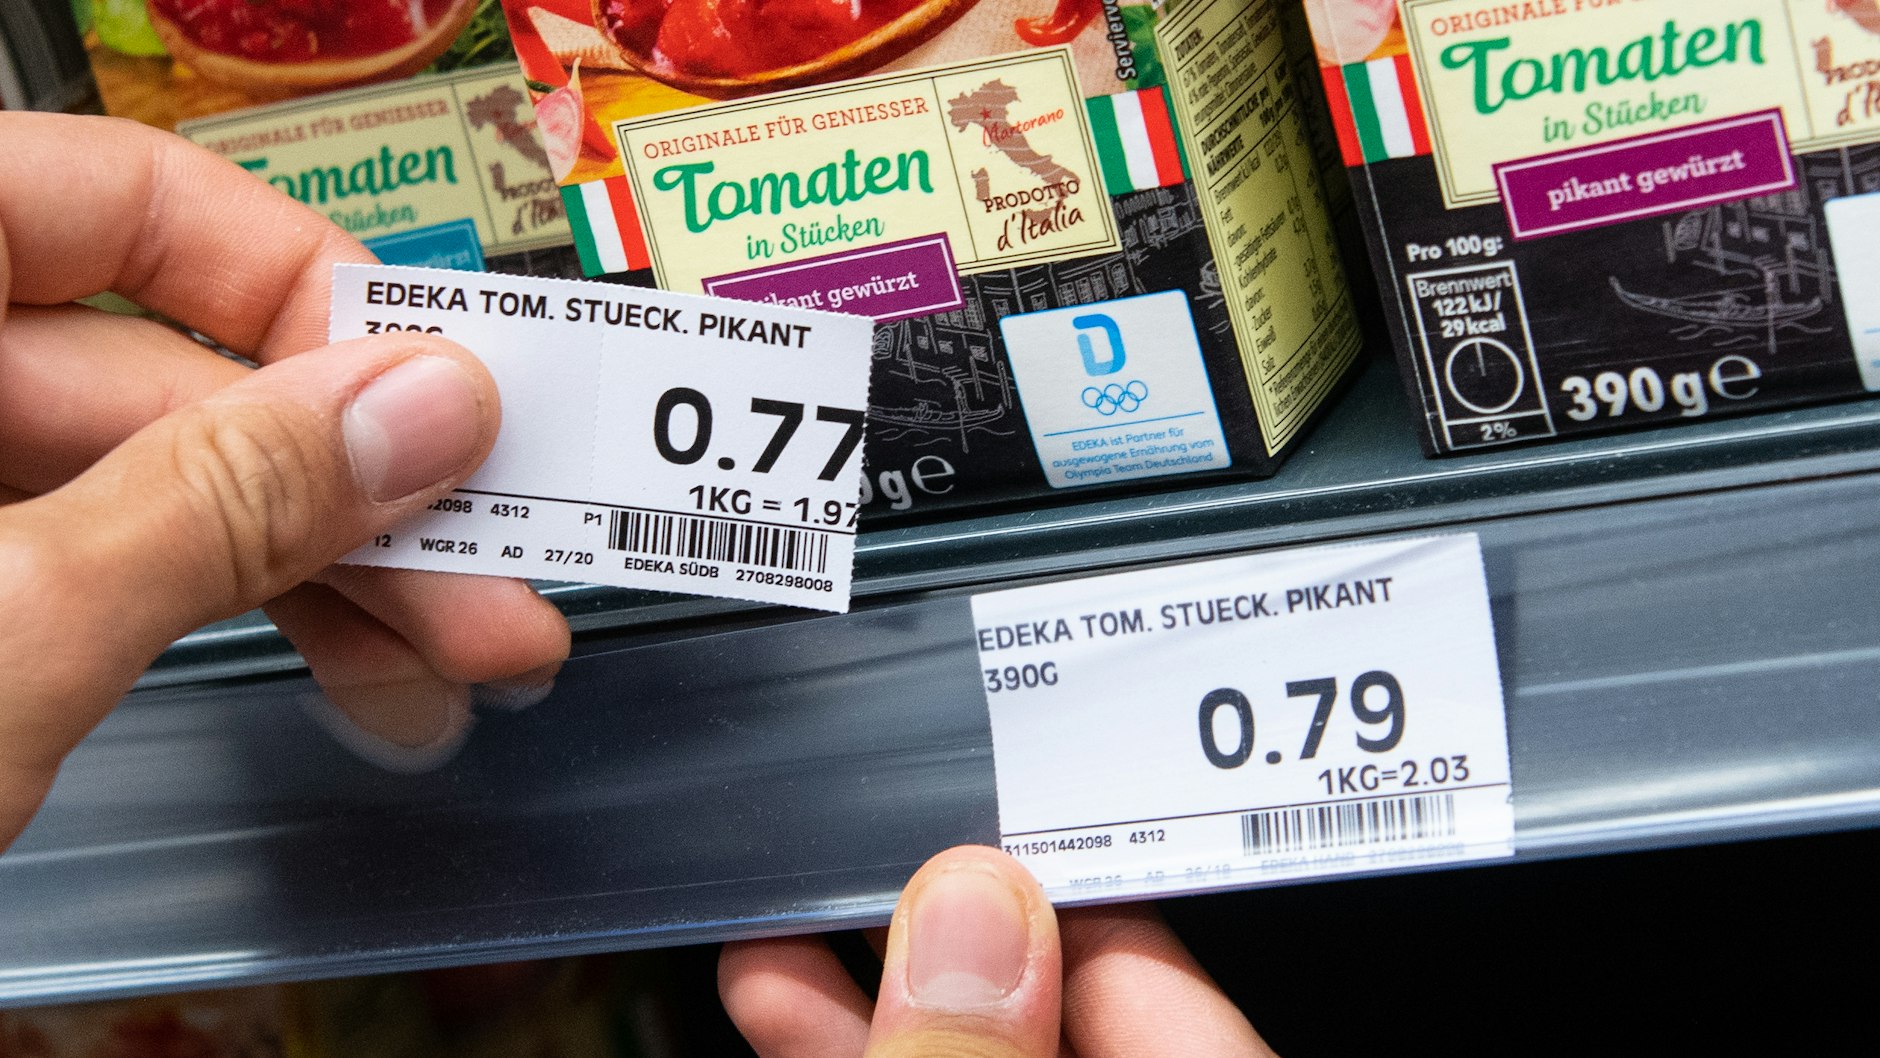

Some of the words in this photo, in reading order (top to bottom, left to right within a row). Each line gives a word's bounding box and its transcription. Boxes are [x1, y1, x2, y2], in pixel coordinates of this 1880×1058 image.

[1431, 0, 1567, 36] ORIGINALE
[1440, 18, 1766, 115] Tomaten
[643, 123, 762, 160] ORIGINALE
[766, 117, 806, 140] FÜR
[811, 97, 929, 132] GENIESSER
[1543, 116, 1575, 144] in
[1581, 89, 1708, 136] Stücken
[236, 145, 458, 206] omaten
[653, 148, 934, 234] Tomaten
[1547, 171, 1632, 211] pikant
[1636, 150, 1745, 193] gewürzt
[983, 179, 1080, 214] PRODOTTO
[747, 234, 775, 262] in
[780, 214, 885, 255] Stücken
[997, 202, 1085, 252] d'Italia
[1406, 239, 1442, 263] Pro
[827, 271, 919, 308] gewürzt
[1415, 271, 1513, 298] Brennwert
[365, 281, 469, 312] EDEKA
[479, 289, 556, 322] TOM.
[566, 298, 690, 335] STUECK.
[697, 312, 812, 349] PIKANT
[1561, 366, 1665, 422] 390
[1671, 372, 1709, 417] g
[654, 387, 865, 481] 0.77
[1072, 438, 1108, 451] EDEKA
[1110, 435, 1123, 447] ist
[1126, 429, 1166, 446] Partner
[1168, 427, 1185, 440] für
[1480, 422, 1517, 442] 2%
[1052, 450, 1127, 469] ausgewogene
[1129, 442, 1187, 461] Ernährung
[1190, 439, 1214, 451] vom
[1064, 464, 1111, 480] Olympia
[1113, 459, 1143, 473] Team
[1145, 452, 1214, 469] Deutschland
[427, 498, 473, 513] 2098
[490, 503, 530, 519] 4312
[583, 512, 603, 528] P1
[689, 485, 752, 514] 1KG
[793, 497, 860, 528] 1.97
[420, 538, 455, 554] WGR
[458, 542, 478, 555] 26
[501, 546, 523, 559] AD
[544, 549, 594, 566] 27/20
[624, 557, 675, 575] EDEKA
[679, 561, 719, 579] SÜDB
[736, 569, 833, 592] 2708298008
[979, 620, 1073, 652] EDEKA
[1080, 609, 1153, 638] TOM.
[1160, 592, 1278, 629] STUECK.
[1285, 577, 1393, 613] PIKANT
[984, 661, 1059, 693] 390G
[1198, 670, 1406, 770] 0.79
[1318, 756, 1470, 796] 1KG=2.03
[1129, 828, 1166, 846] 4312
